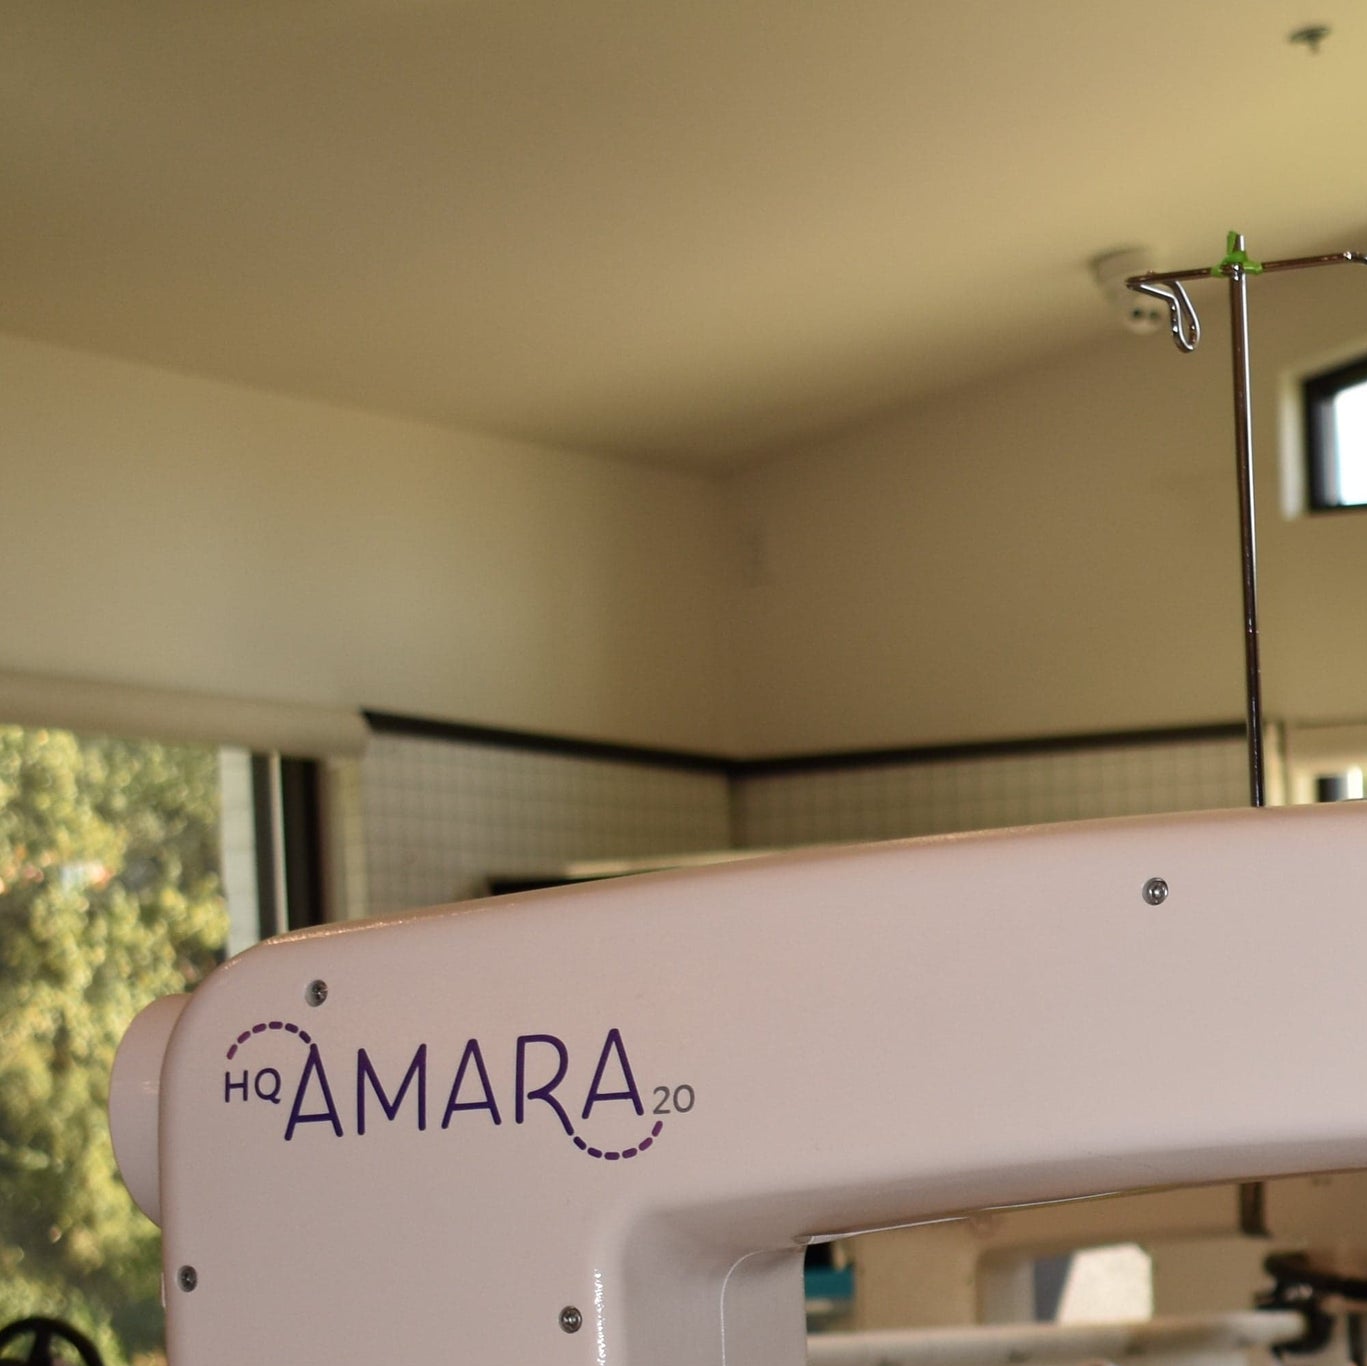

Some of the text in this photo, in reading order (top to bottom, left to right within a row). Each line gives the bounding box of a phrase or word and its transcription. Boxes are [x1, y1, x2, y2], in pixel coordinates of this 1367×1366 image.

[224, 1028, 696, 1142] HQ AMARA 20
